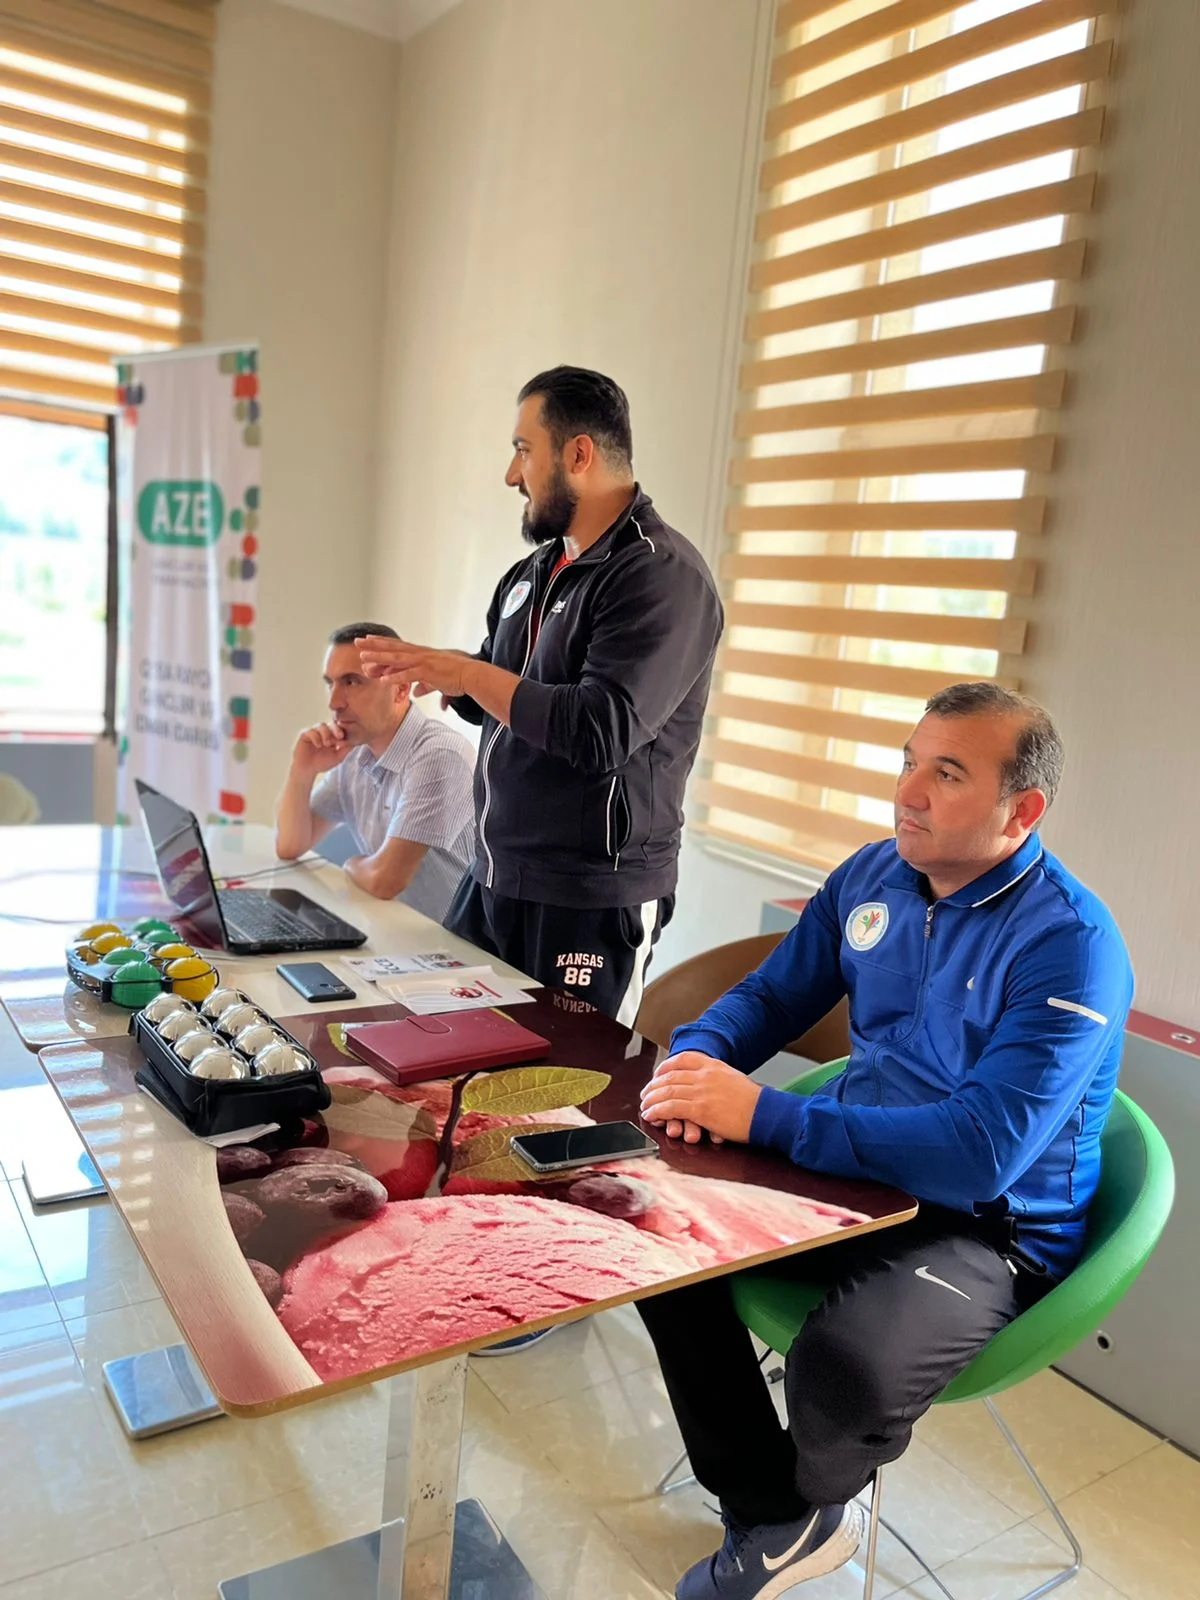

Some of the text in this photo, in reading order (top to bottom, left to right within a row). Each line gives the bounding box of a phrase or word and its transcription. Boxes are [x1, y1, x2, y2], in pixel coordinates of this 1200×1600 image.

[151, 491, 210, 537] AZE
[556, 953, 604, 968] KANSAS
[564, 967, 592, 986] 86
